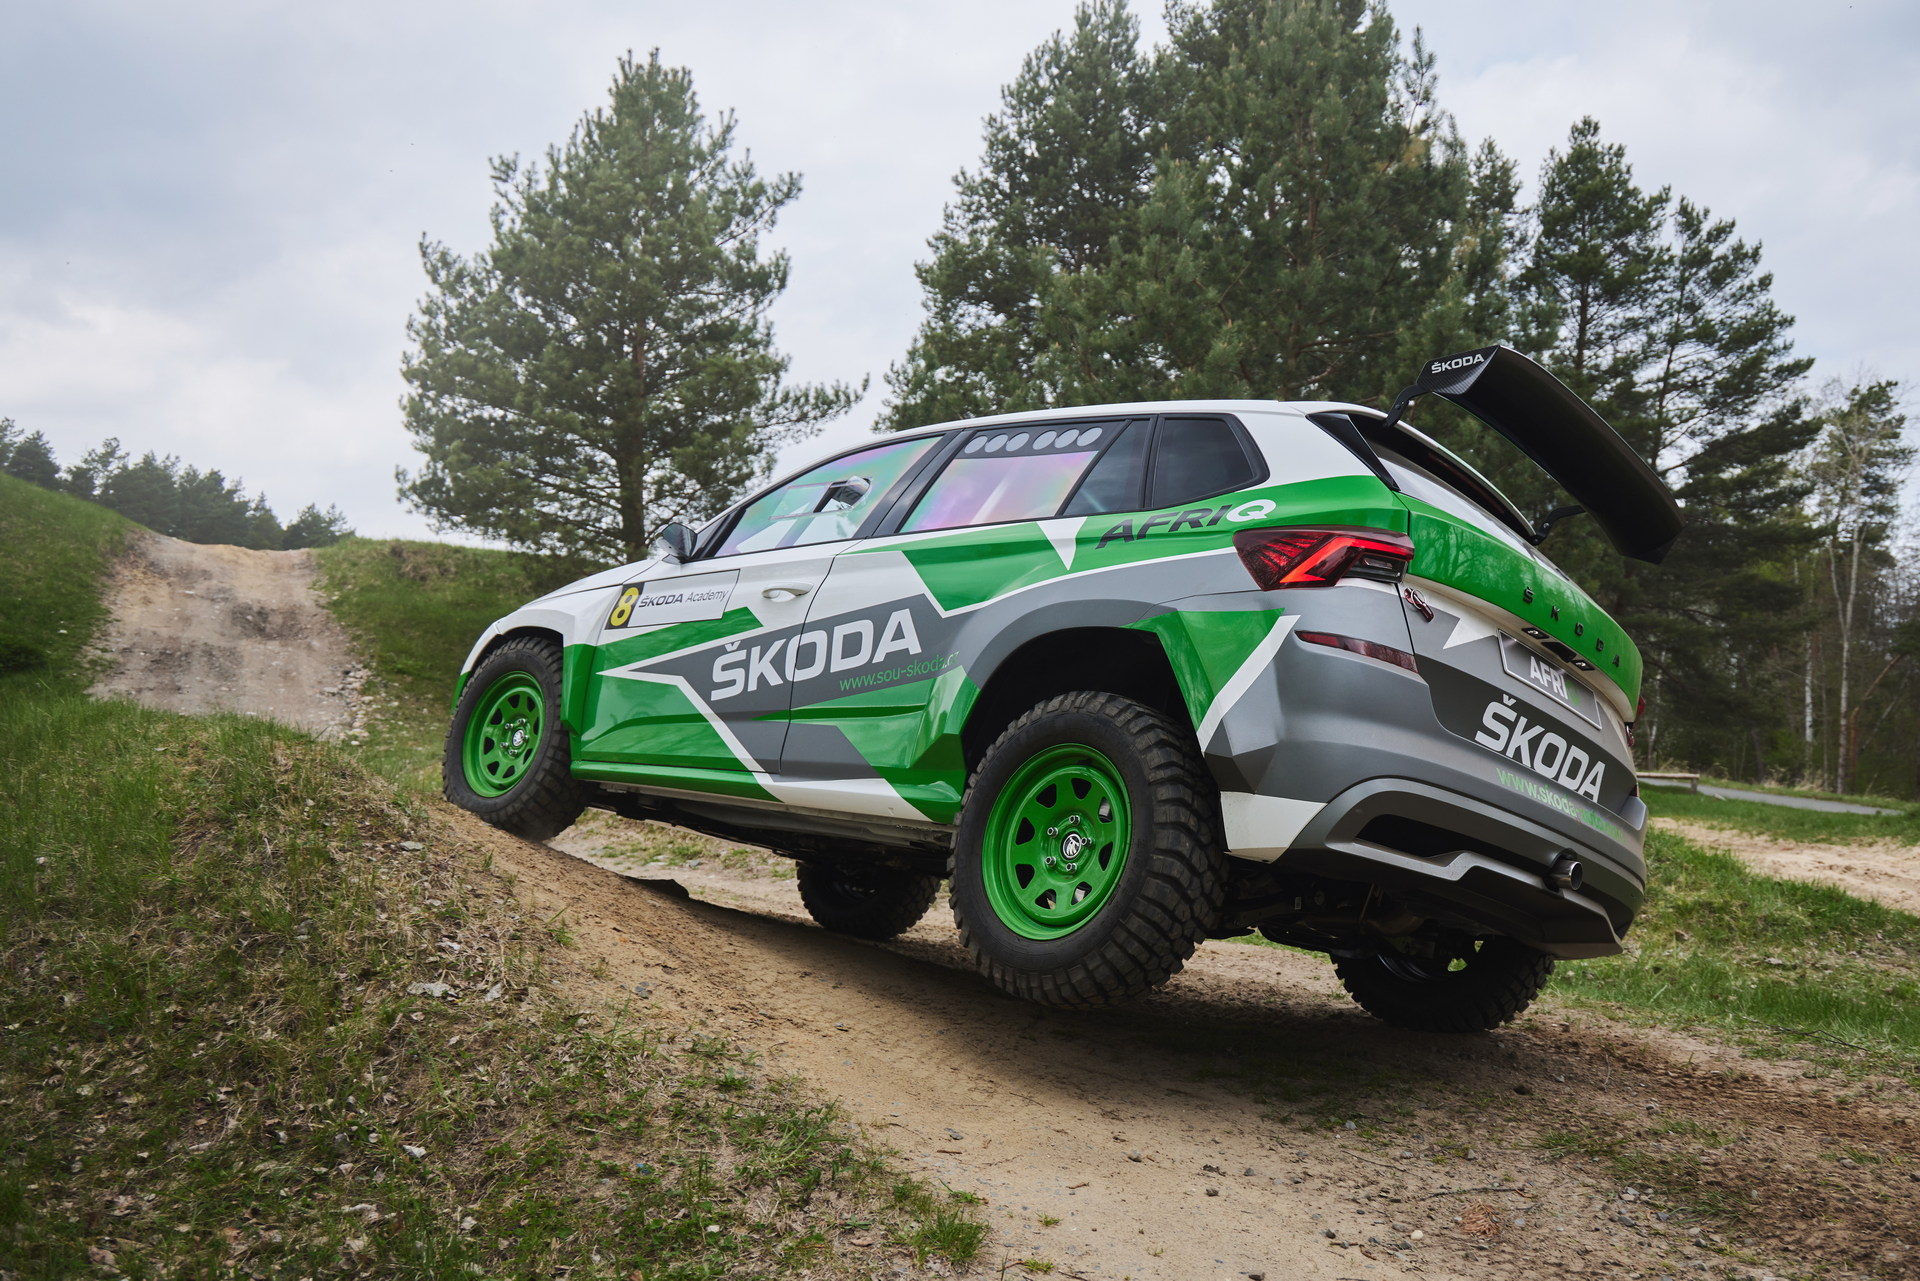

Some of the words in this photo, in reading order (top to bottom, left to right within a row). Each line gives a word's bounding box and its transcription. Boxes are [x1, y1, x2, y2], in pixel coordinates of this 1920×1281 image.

[1431, 353, 1485, 374] ŠKODA
[1095, 499, 1277, 550] AFRIQ
[610, 587, 640, 627] 8
[638, 593, 683, 608] ŠKODA
[685, 589, 729, 603] Academy
[1522, 586, 1620, 668] ŠKODA
[710, 608, 922, 701] ŠKODA
[839, 651, 960, 692] www.sou-skoda.cz
[1474, 693, 1606, 803] ŠKODA
